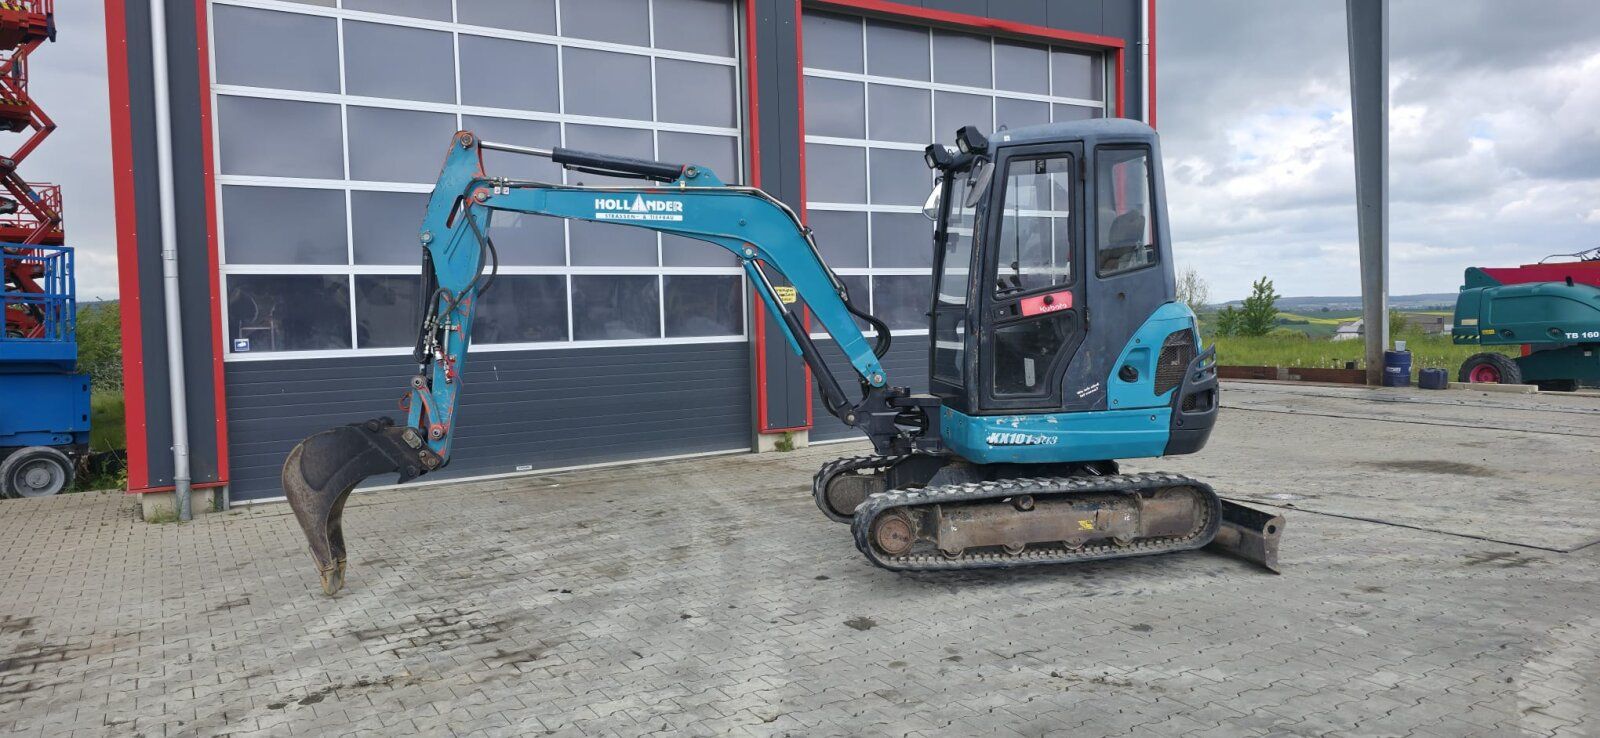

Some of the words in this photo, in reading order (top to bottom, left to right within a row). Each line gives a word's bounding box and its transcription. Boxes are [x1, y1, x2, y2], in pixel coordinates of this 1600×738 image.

[595, 194, 683, 212] HOLLANDER
[1039, 303, 1067, 312] Kubota
[1582, 331, 1599, 339] 160
